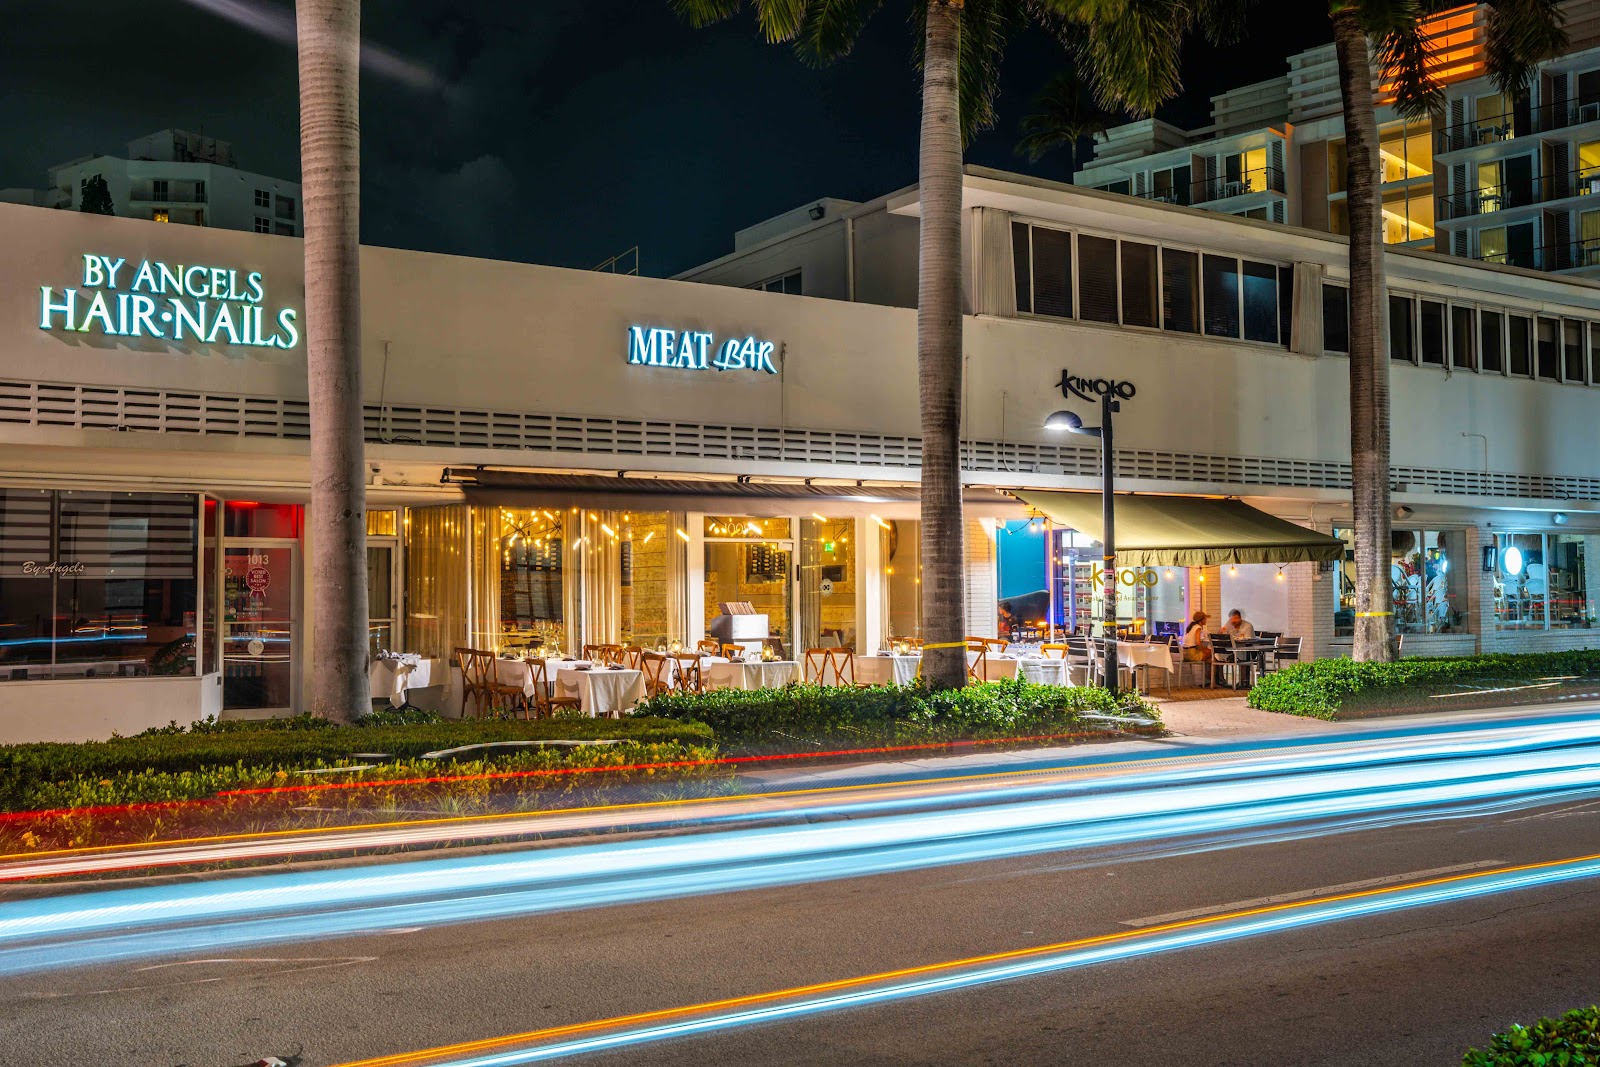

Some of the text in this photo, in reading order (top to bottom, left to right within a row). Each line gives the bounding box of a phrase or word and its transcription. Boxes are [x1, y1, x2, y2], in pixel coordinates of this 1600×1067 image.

[82, 254, 264, 303] BY ANGELS
[627, 326, 778, 375] MEAT BAR
[1055, 369, 1136, 403] KINOKO
[23, 561, 85, 577] By Angels
[247, 554, 269, 565] 1013
[1087, 562, 1159, 594] KOKO
